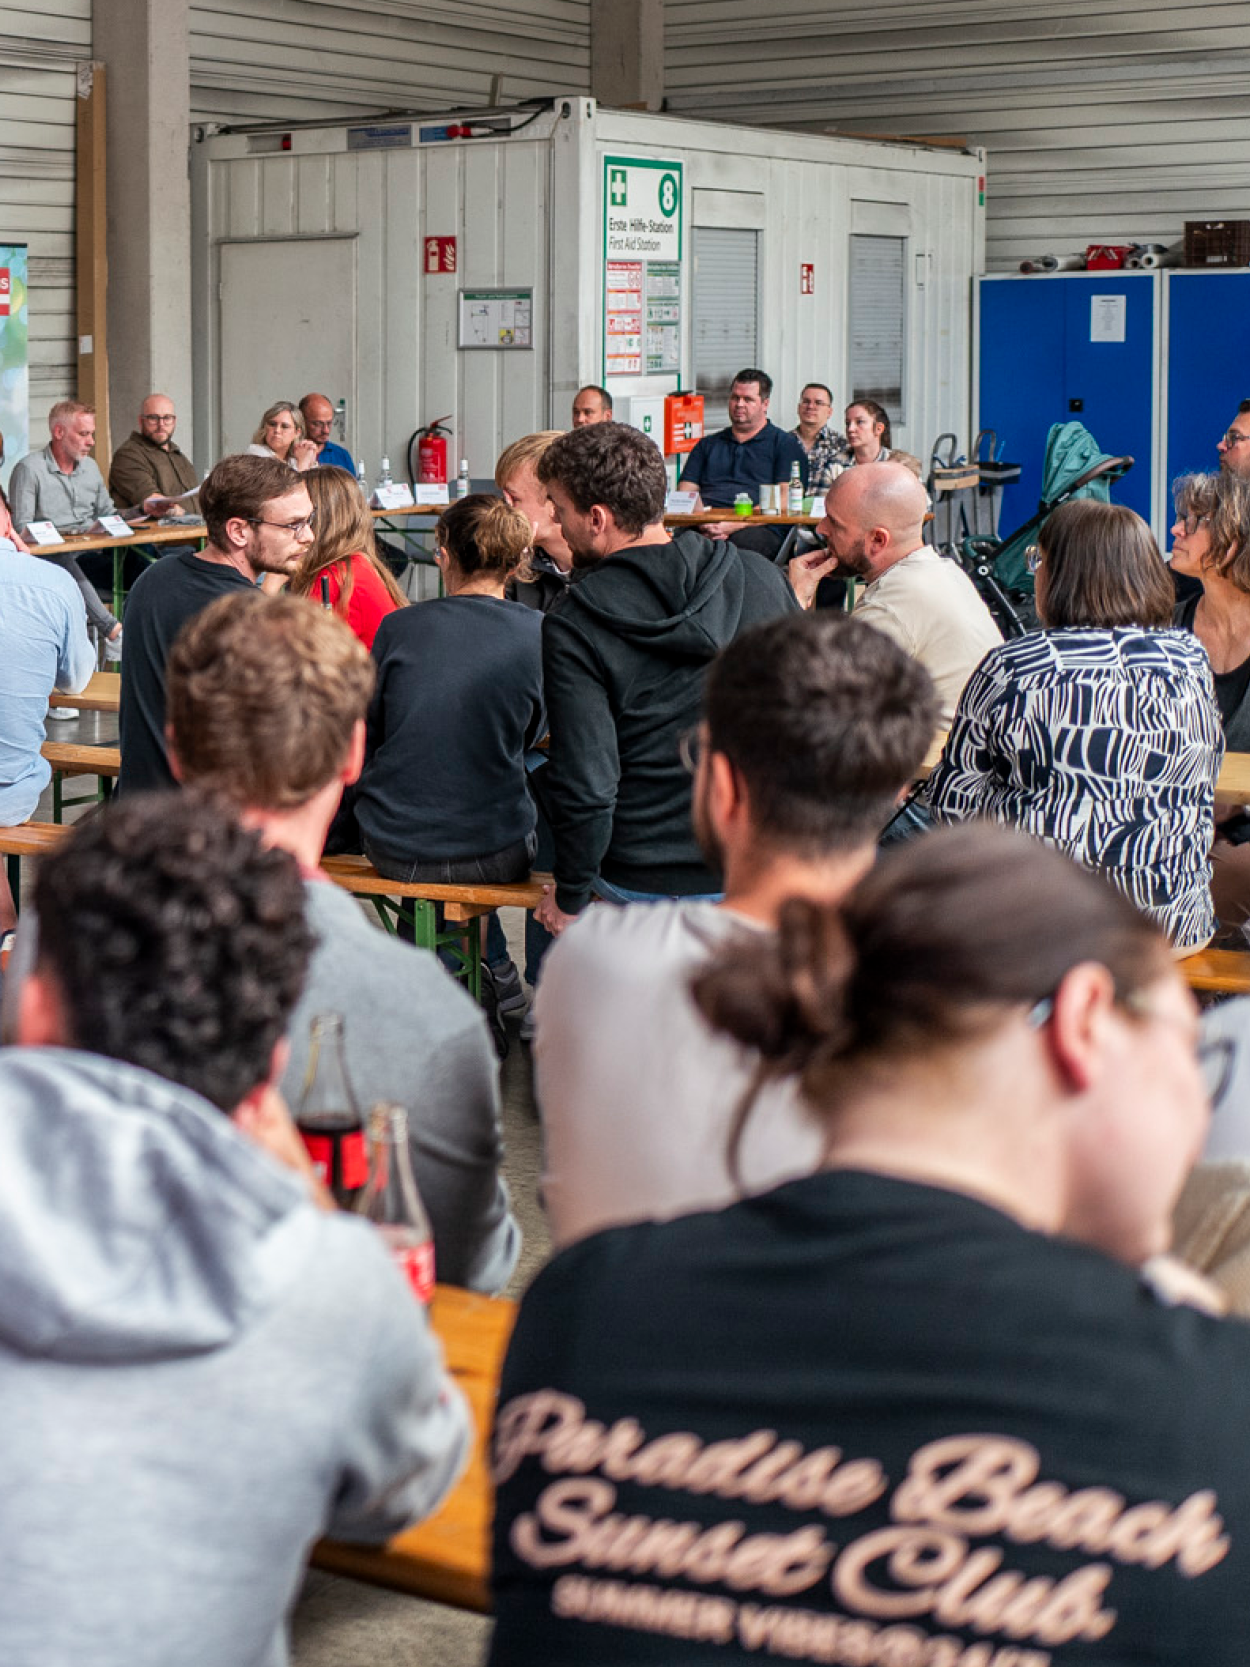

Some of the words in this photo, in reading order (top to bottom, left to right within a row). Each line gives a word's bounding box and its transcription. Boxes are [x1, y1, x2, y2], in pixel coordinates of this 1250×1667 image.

[662, 179, 674, 211] 8
[609, 217, 627, 231] Erste
[609, 236, 624, 250] First
[625, 236, 637, 250] Aid
[636, 236, 661, 251] Station
[491, 1388, 886, 1516] Paradise
[889, 1432, 1231, 1579] Beach
[510, 1476, 835, 1597] Sunset
[831, 1523, 1118, 1647] Club
